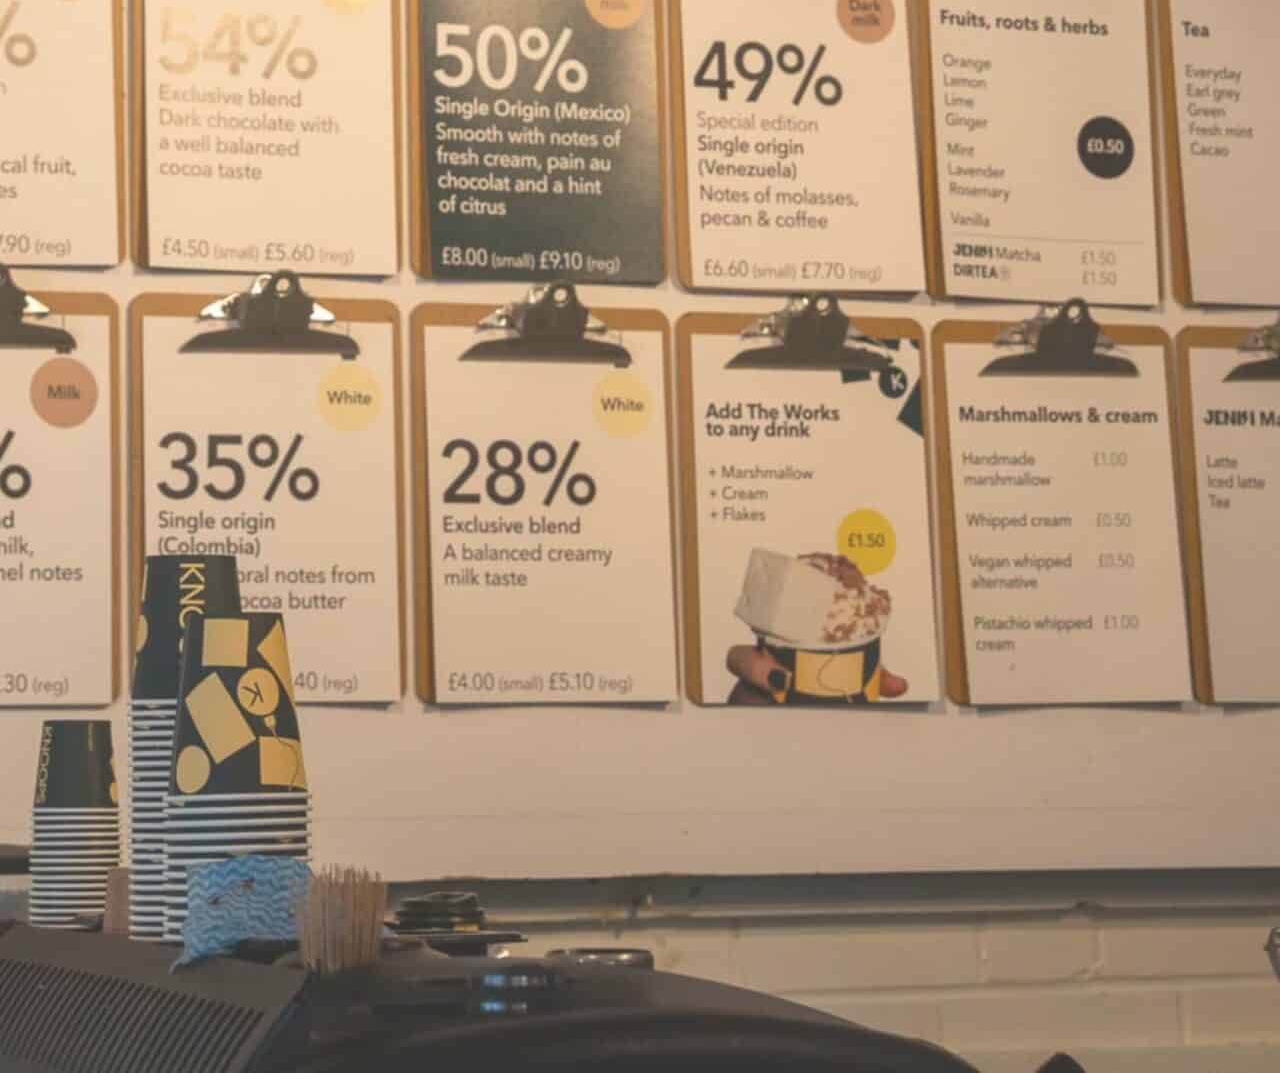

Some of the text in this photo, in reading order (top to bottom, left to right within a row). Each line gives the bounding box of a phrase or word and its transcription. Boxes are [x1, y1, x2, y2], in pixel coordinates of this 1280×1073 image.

[940, 9, 1108, 37] Fruits, roots & herbs
[1182, 20, 1210, 38] Tea
[432, 21, 588, 93] 50%
[940, 53, 992, 73] Orange
[694, 41, 842, 107] 49%
[158, 85, 303, 108] Exclusive blend
[436, 124, 621, 148] Smooth with notes of
[1088, 137, 1124, 154] £0.50
[160, 160, 264, 184] cocoa taste
[698, 158, 796, 181] (Venezuela)
[701, 209, 828, 230] pecan & coffee
[327, 390, 371, 406] White
[705, 404, 840, 422] Add The Works
[959, 406, 1158, 424] Marshmallows & cream
[704, 419, 809, 442] to any drink
[157, 431, 319, 502] 35%
[442, 439, 596, 507] 28%
[966, 513, 1072, 530] Whipped cream
[848, 532, 885, 548] £1.50
[443, 542, 612, 567] A balanced creamy
[30, 566, 83, 581] notes
